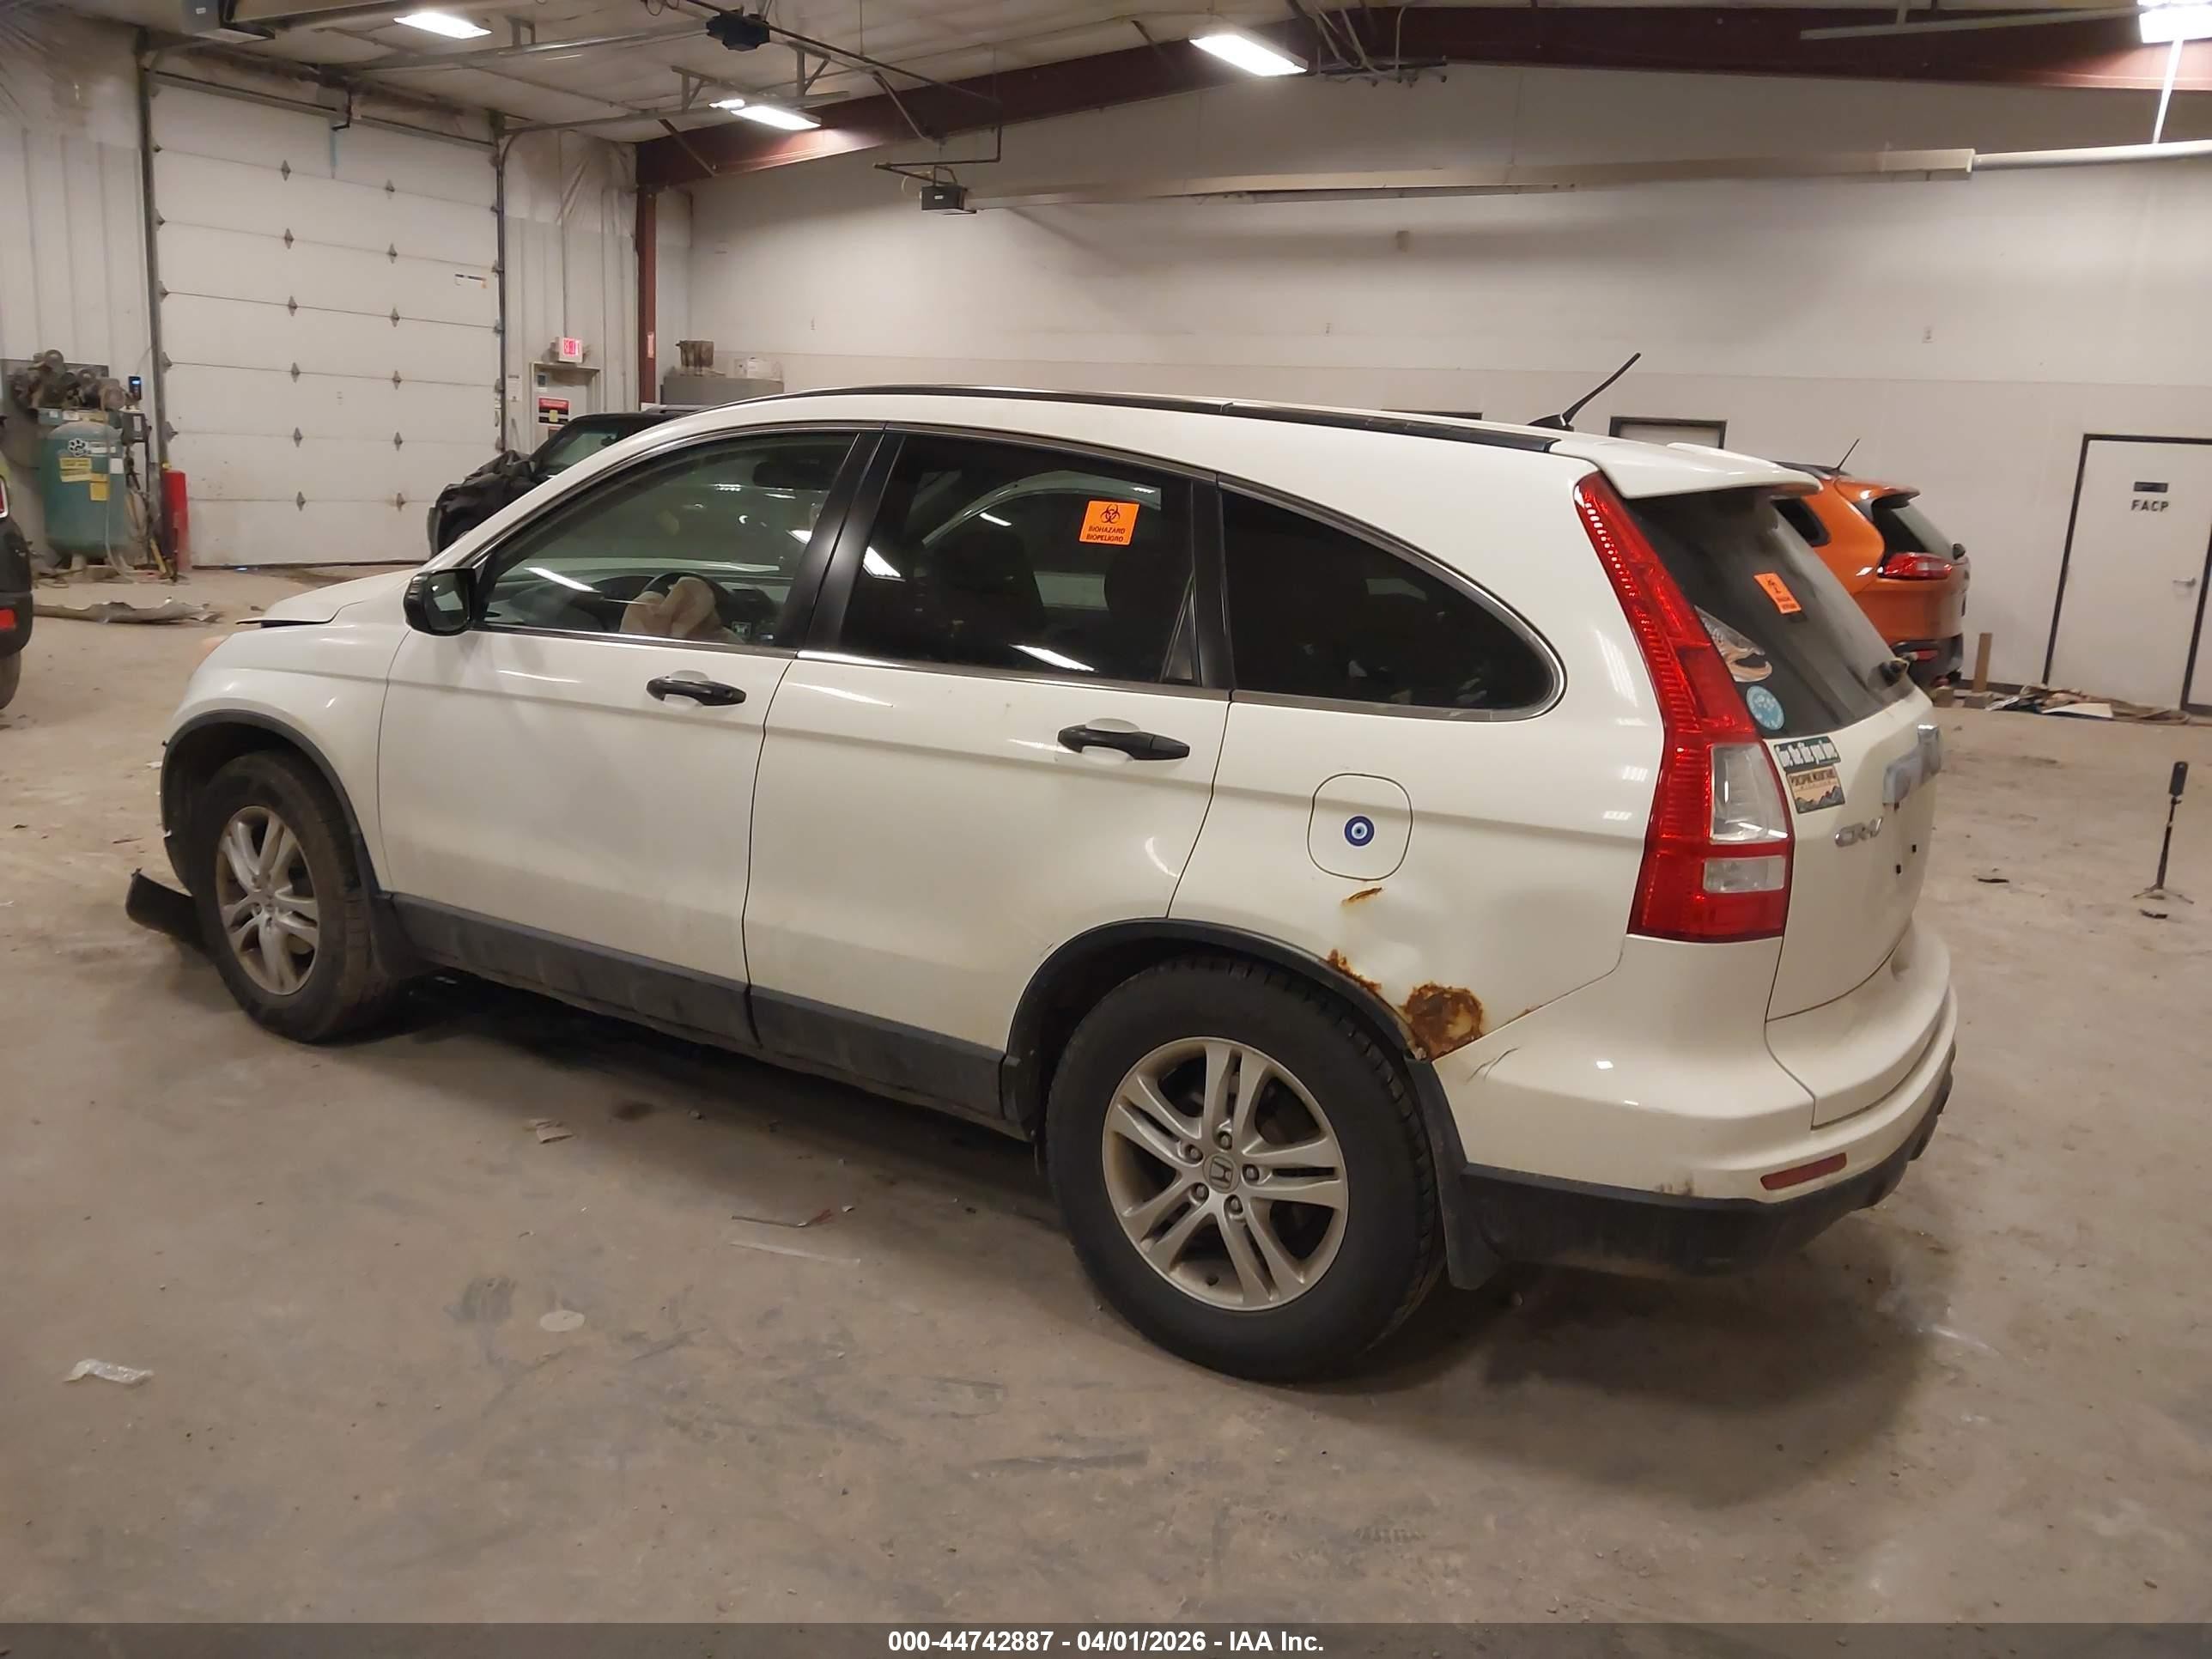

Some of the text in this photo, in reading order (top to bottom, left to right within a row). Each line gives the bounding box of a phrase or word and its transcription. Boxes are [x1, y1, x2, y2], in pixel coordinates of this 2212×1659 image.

[2130, 499, 2169, 512] FACP
[1088, 526, 1126, 535] BIOHAZARD
[1085, 533, 1124, 543] BIOPELIGRO
